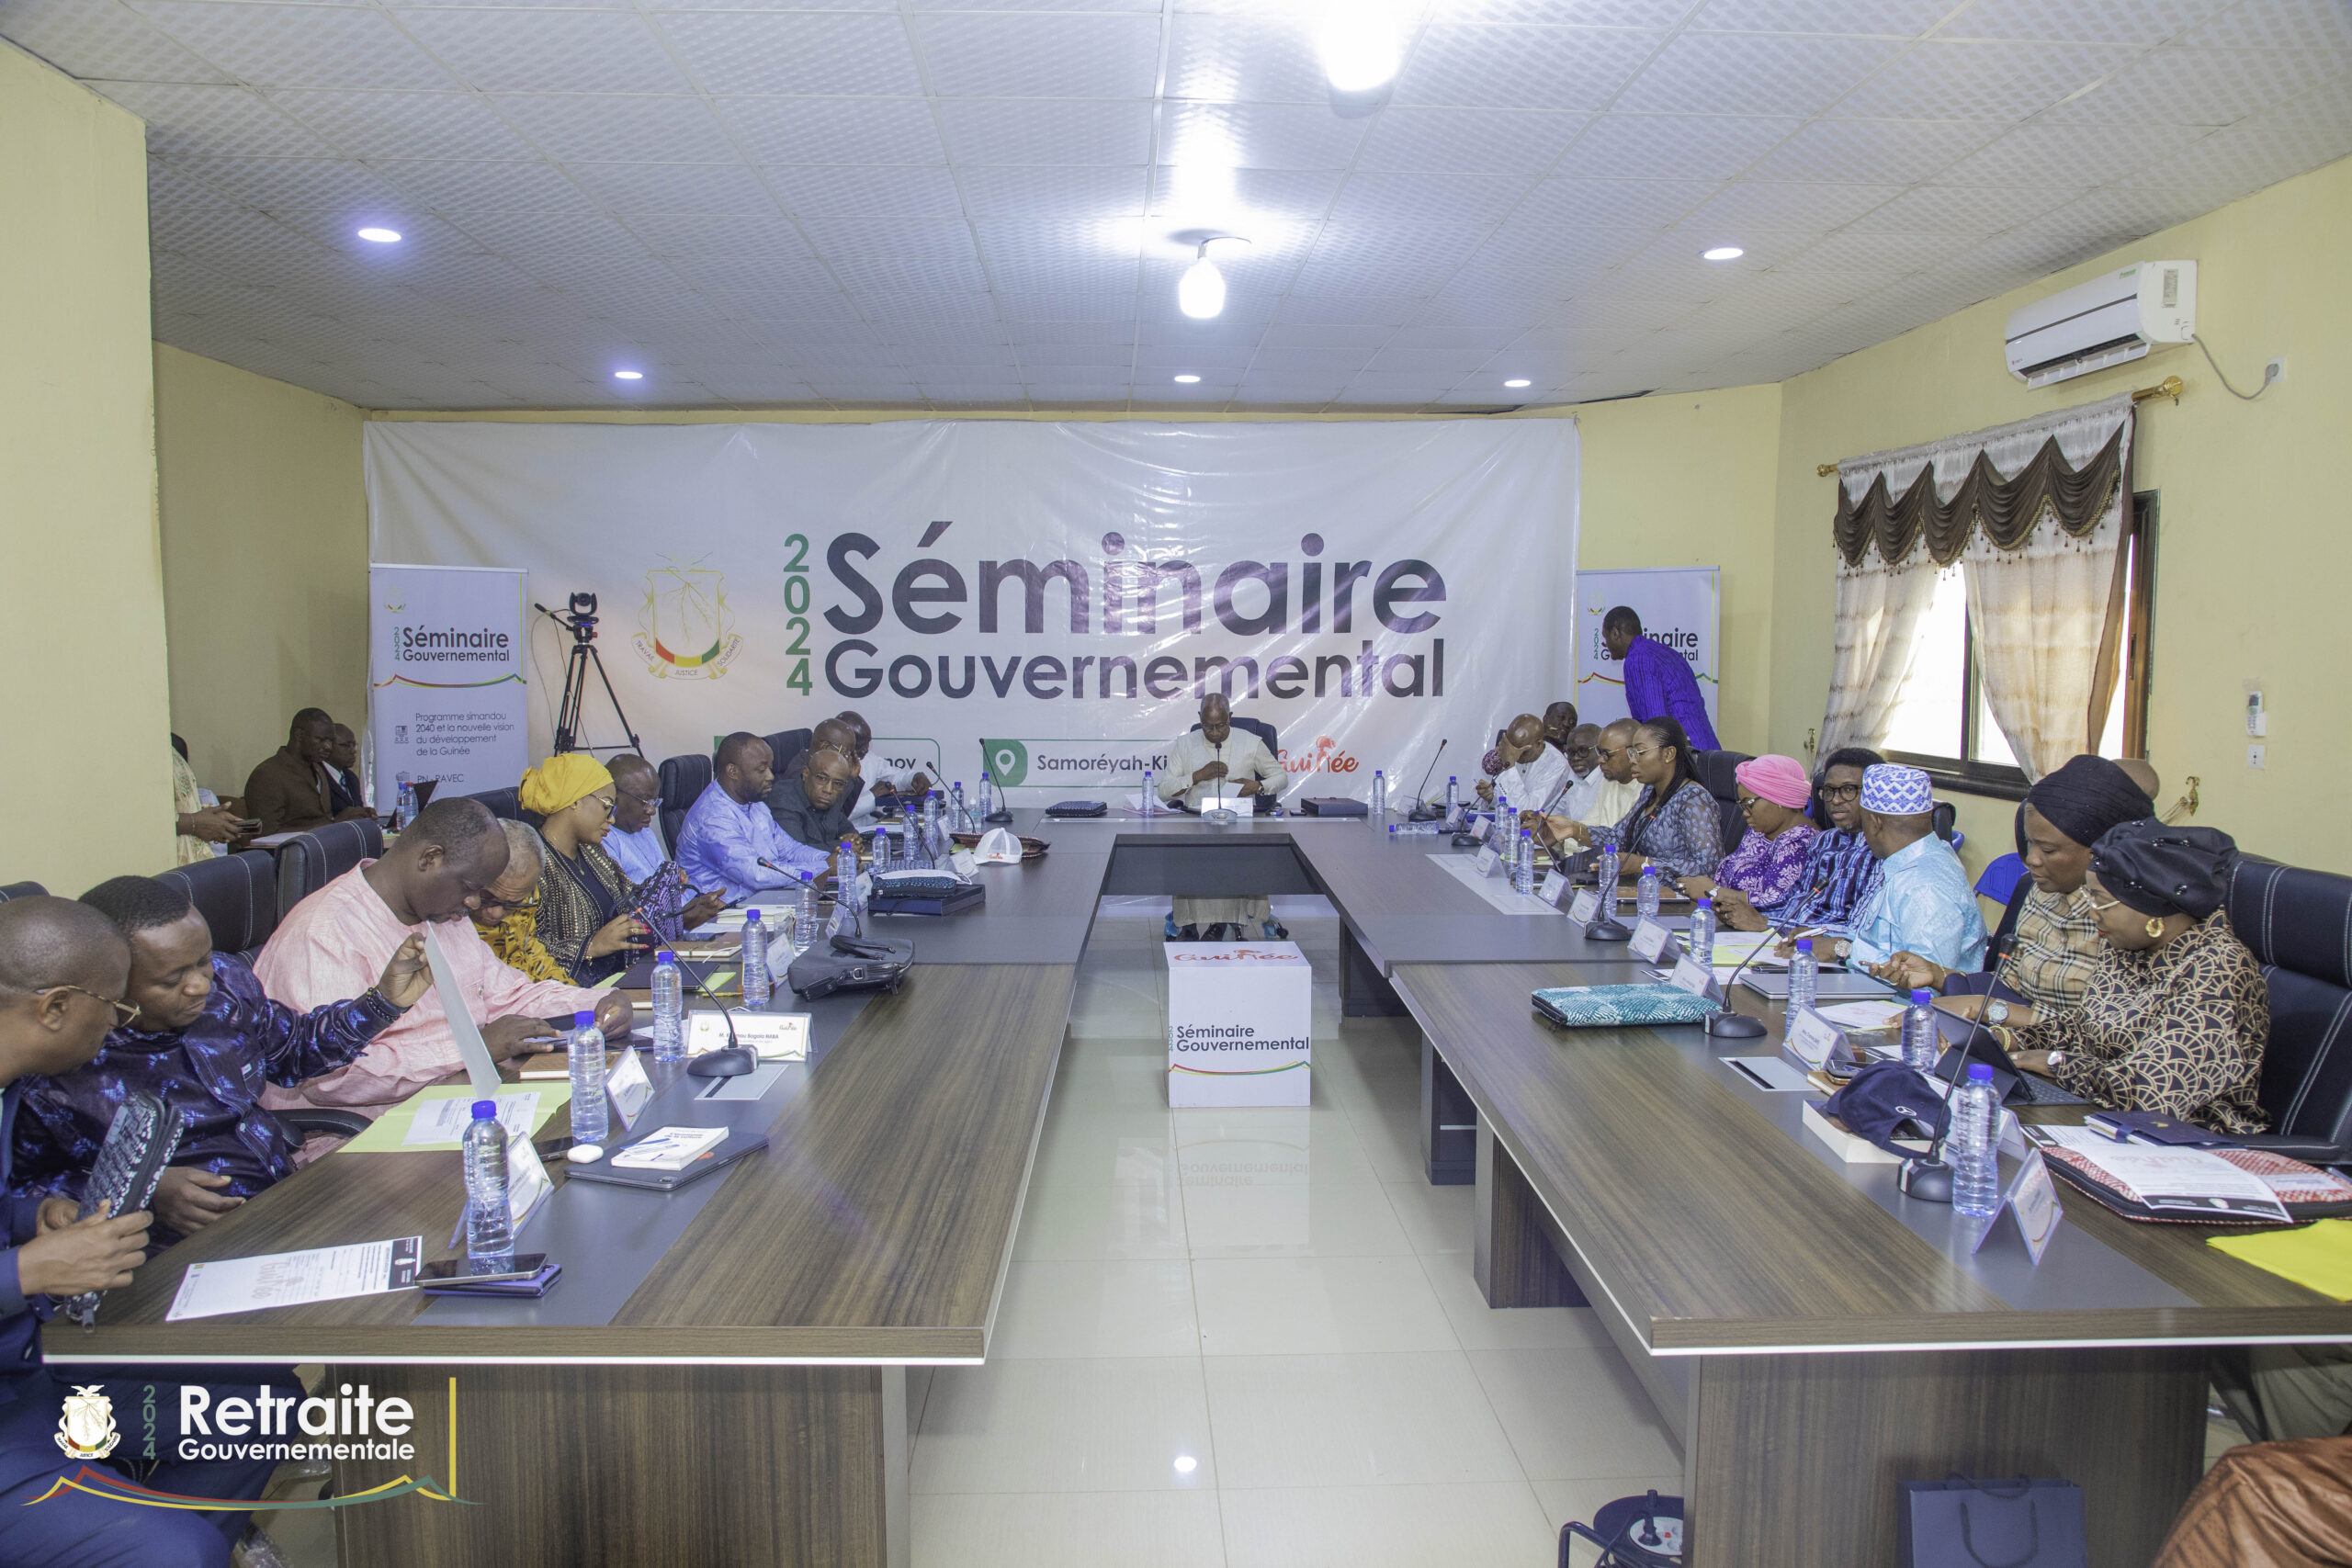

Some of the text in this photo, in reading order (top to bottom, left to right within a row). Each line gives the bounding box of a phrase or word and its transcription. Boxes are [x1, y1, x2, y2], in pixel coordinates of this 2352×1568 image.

[822, 521, 1447, 636] Séminaire
[783, 533, 813, 696] 2024
[402, 625, 509, 648] Séminaire
[402, 649, 510, 662] Gouvernemental
[825, 637, 1445, 700] Gouvernemental
[415, 712, 506, 723] Programme simandou
[415, 724, 435, 733] 2040
[447, 724, 455, 732] la
[457, 723, 491, 732] nouvelle
[493, 723, 515, 731] vision
[416, 734, 497, 745] du développement
[416, 745, 470, 756] de la Guinée
[1037, 753, 1168, 774] Samoréyah-Ki
[417, 774, 430, 783] PN
[435, 773, 464, 783] RAVEC
[1176, 1024, 1255, 1039] Séminaire
[1176, 1036, 1310, 1053] Gouvernemental
